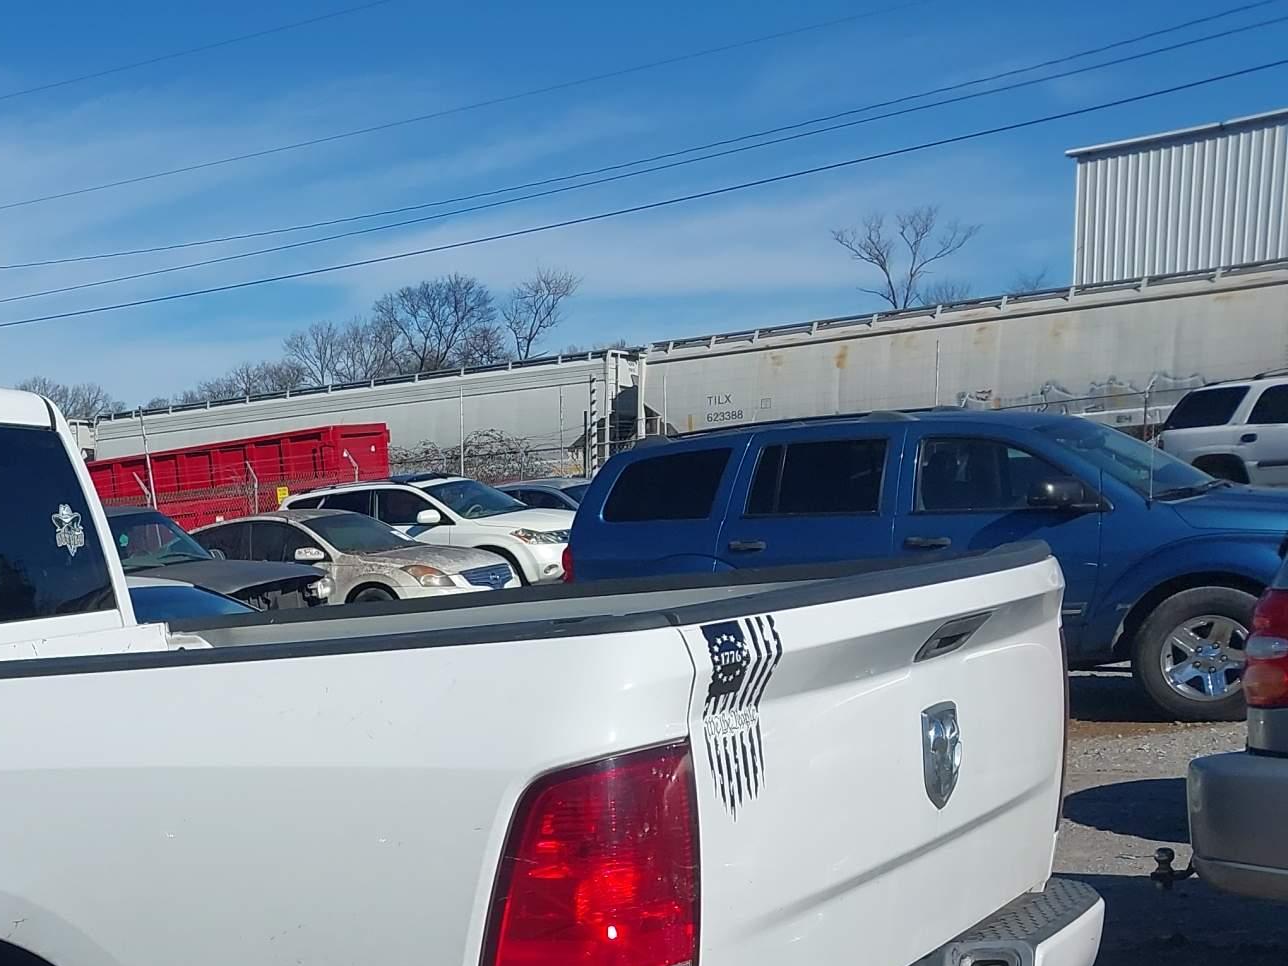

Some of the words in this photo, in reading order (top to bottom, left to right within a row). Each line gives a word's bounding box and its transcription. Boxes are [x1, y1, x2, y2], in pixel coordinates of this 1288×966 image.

[707, 394, 732, 406] TILX
[706, 409, 744, 422] 623388
[720, 650, 742, 665] 1776
